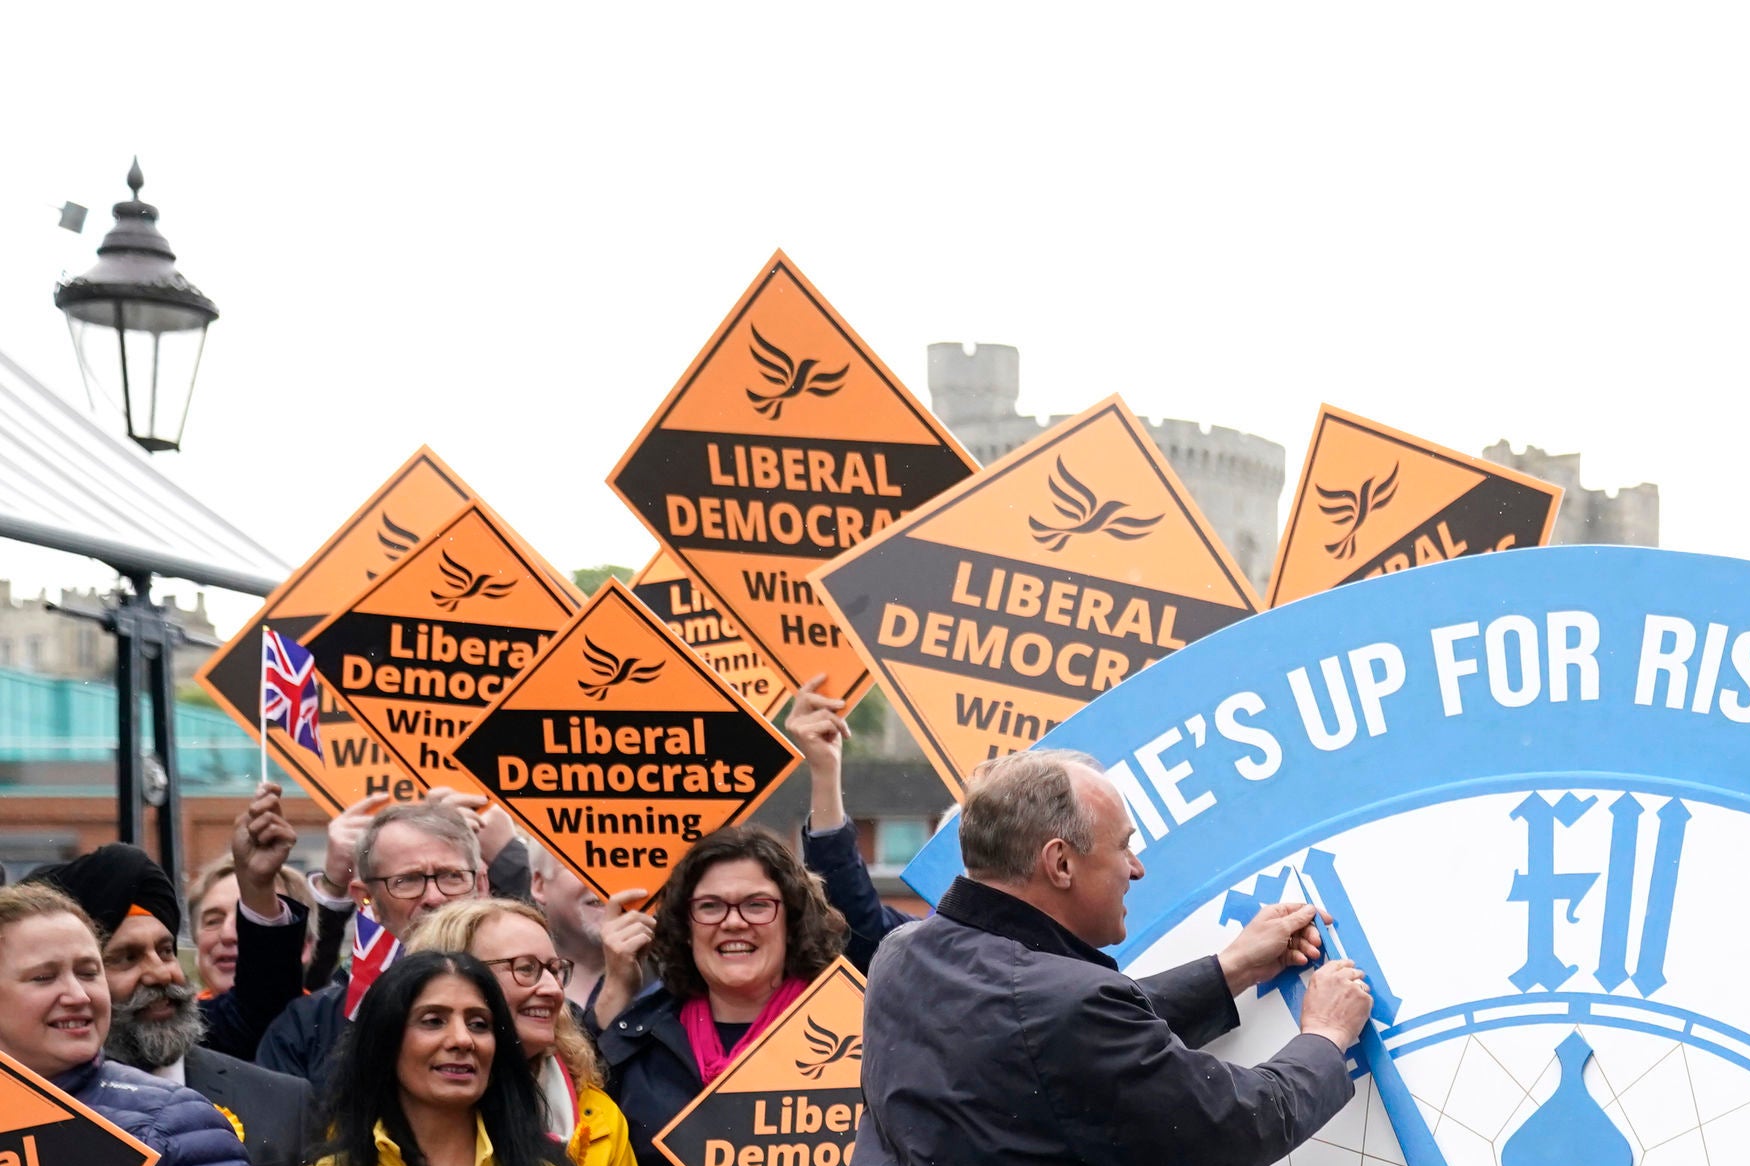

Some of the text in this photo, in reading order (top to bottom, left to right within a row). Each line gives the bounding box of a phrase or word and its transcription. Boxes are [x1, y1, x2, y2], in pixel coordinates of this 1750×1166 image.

[707, 442, 903, 497] LIBERAL
[951, 560, 1187, 651] LIBERAL
[780, 614, 854, 649] Her
[877, 603, 1158, 693] DEMOCR
[342, 654, 513, 702] Democ
[1287, 641, 1406, 752] UP
[1430, 610, 1600, 717] FOR
[542, 716, 707, 755] Liberal
[497, 755, 756, 793] Democrats
[547, 806, 702, 842] Winning
[585, 840, 668, 868] here
